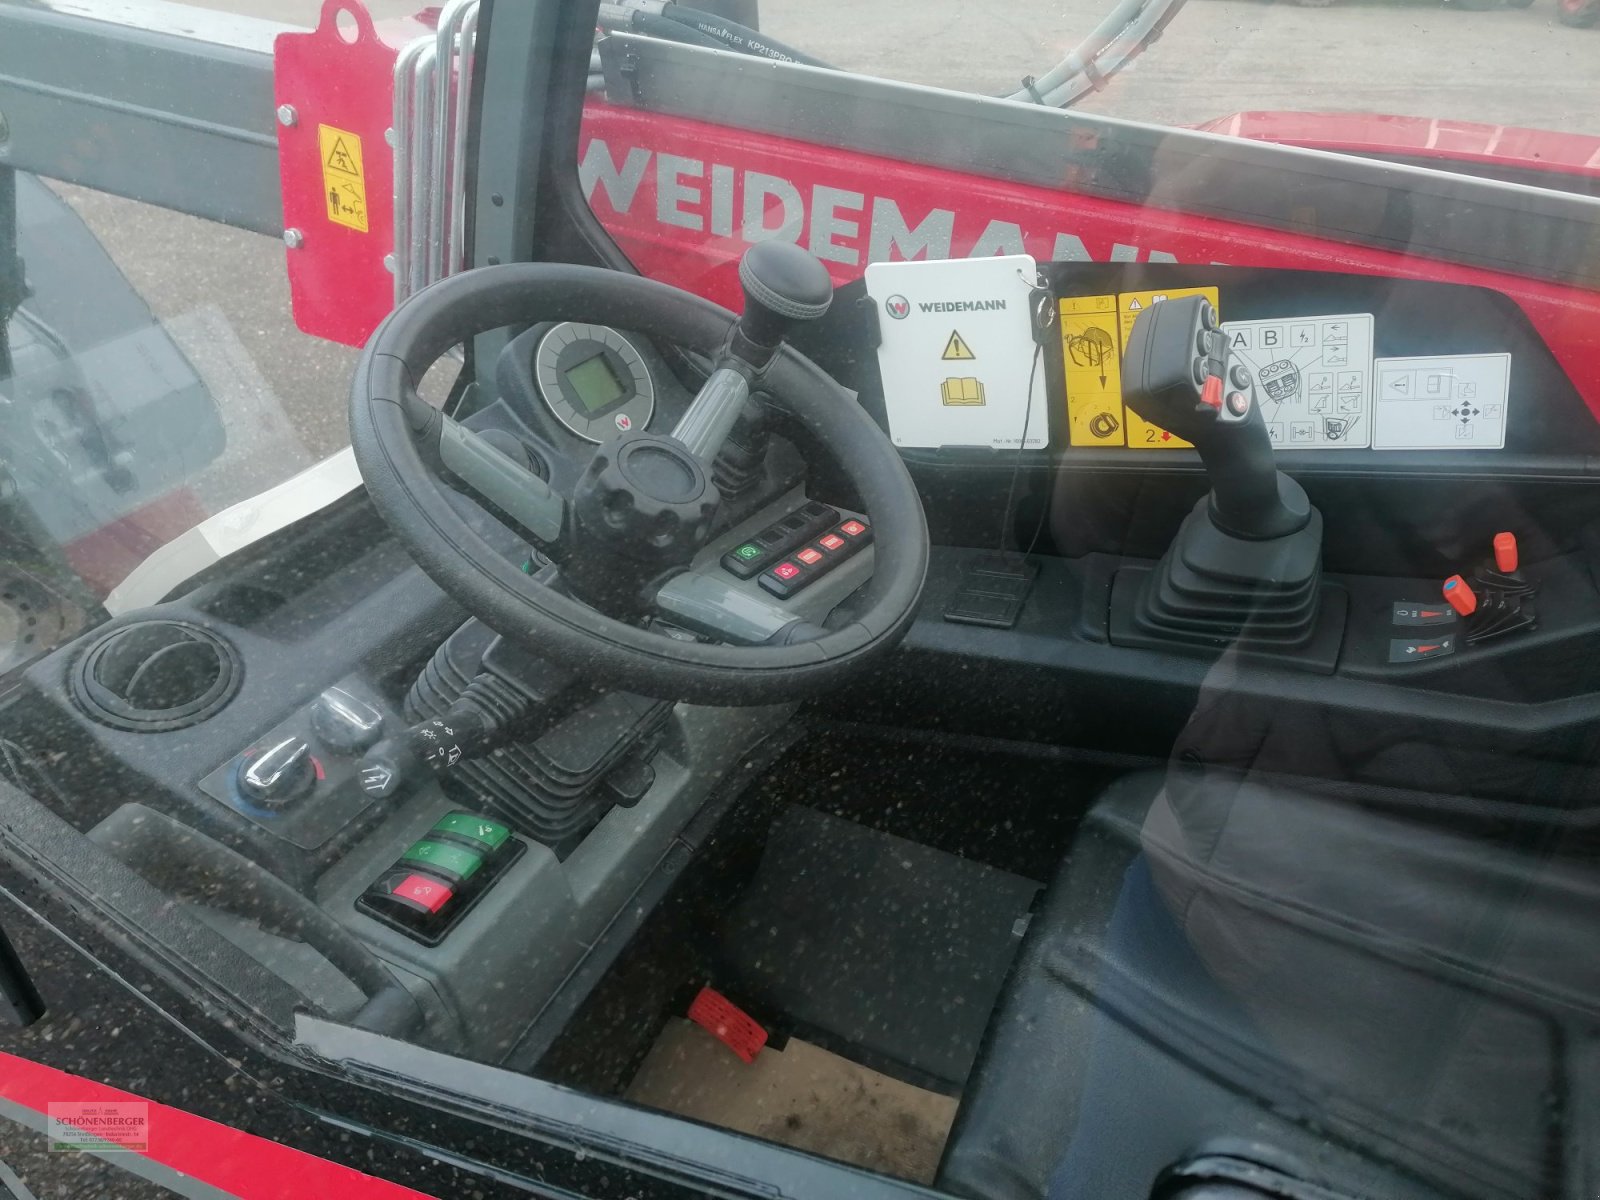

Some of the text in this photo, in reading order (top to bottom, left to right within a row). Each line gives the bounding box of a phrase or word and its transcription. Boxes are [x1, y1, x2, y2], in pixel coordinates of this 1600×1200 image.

[918, 300, 1007, 313] WEIDEMANN
[1232, 332, 1248, 348] A
[1264, 330, 1278, 346] B
[1145, 429, 1161, 443] 2.
